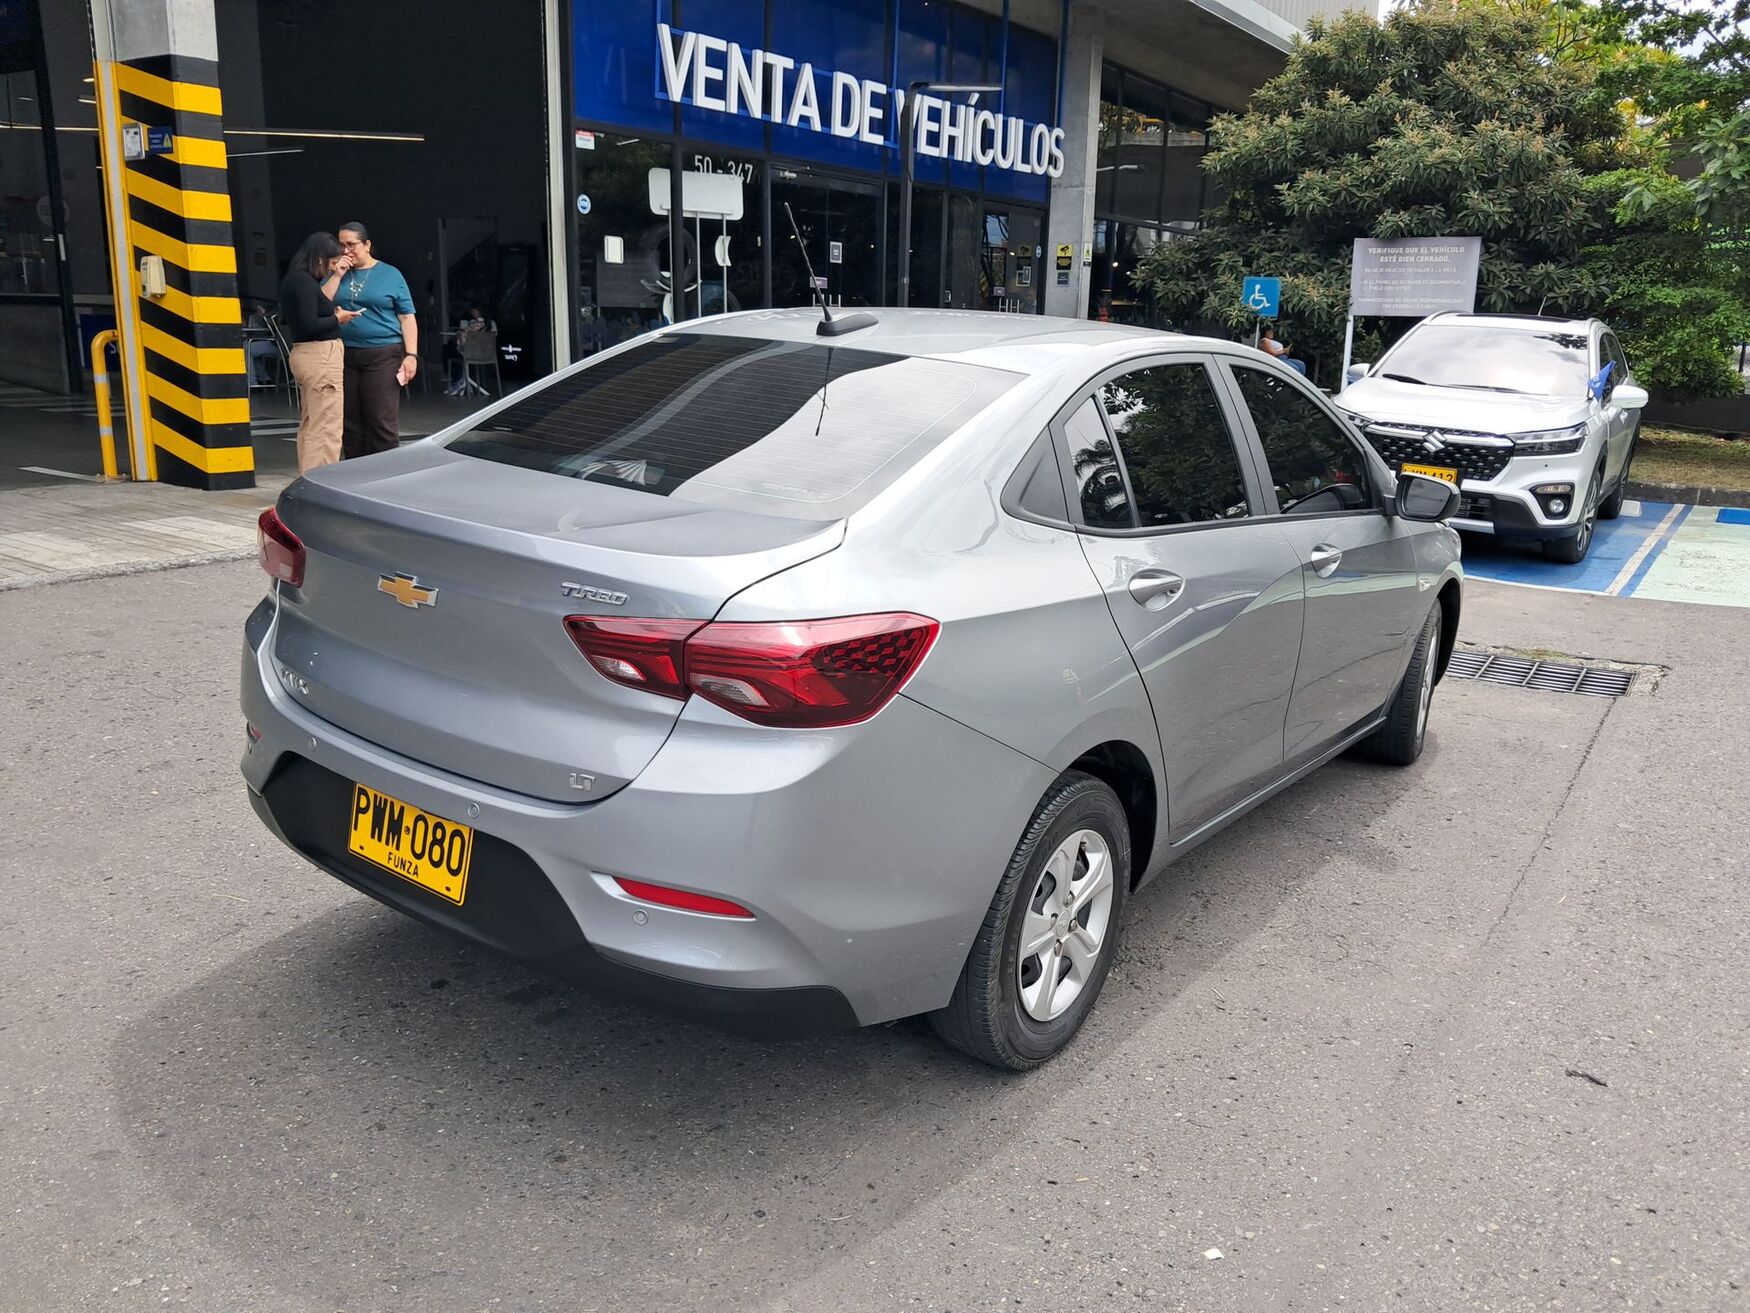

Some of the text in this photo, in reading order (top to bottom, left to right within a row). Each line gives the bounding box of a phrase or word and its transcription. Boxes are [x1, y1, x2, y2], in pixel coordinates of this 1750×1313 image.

[657, 23, 1066, 178] VENTA DE VEHÍCULOS
[694, 155, 712, 176] 50
[1368, 247, 1404, 255] VERIFIQUE
[1430, 245, 1465, 253] VEHÍCULO
[1379, 254, 1397, 263] ESTÉ
[560, 581, 630, 606] TURBO
[569, 772, 596, 791] LT
[387, 851, 419, 878] FUNZA
